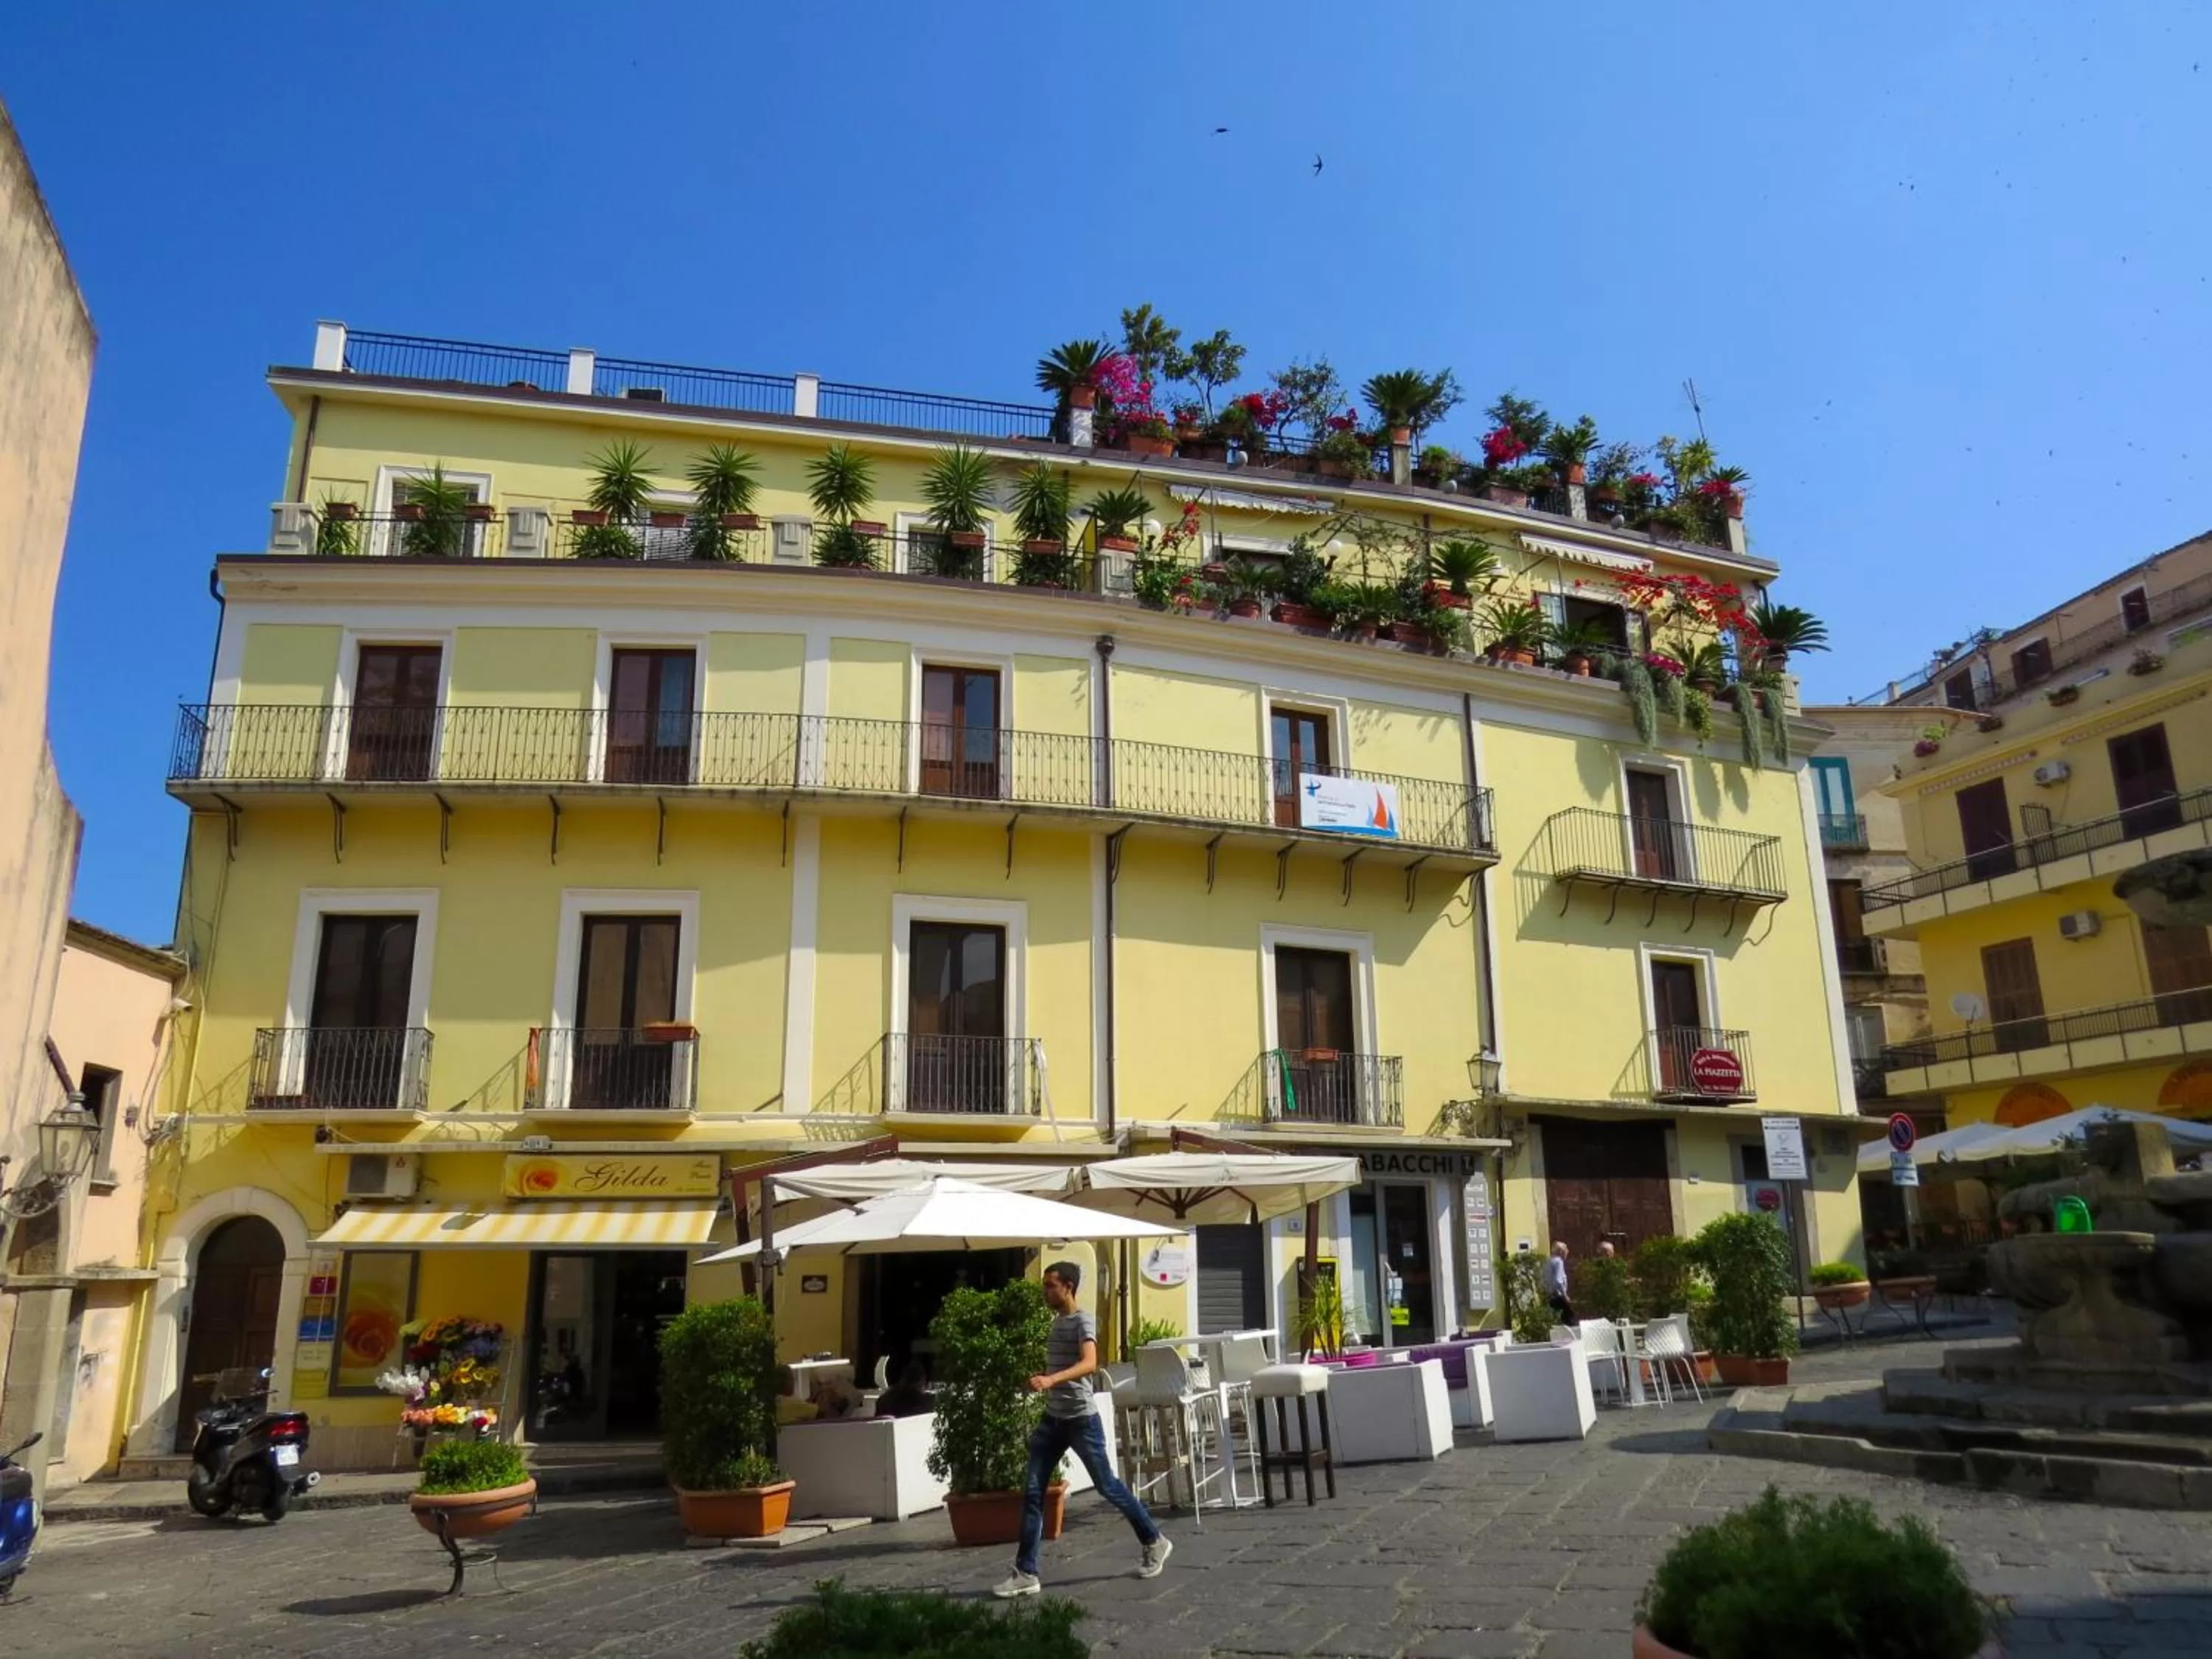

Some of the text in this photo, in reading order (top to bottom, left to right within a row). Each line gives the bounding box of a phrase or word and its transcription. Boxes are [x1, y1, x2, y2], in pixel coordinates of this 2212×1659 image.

[1694, 1067, 1704, 1076] LA
[1339, 1152, 1453, 1174] ABACCHI
[574, 1161, 670, 1192] Gilda
